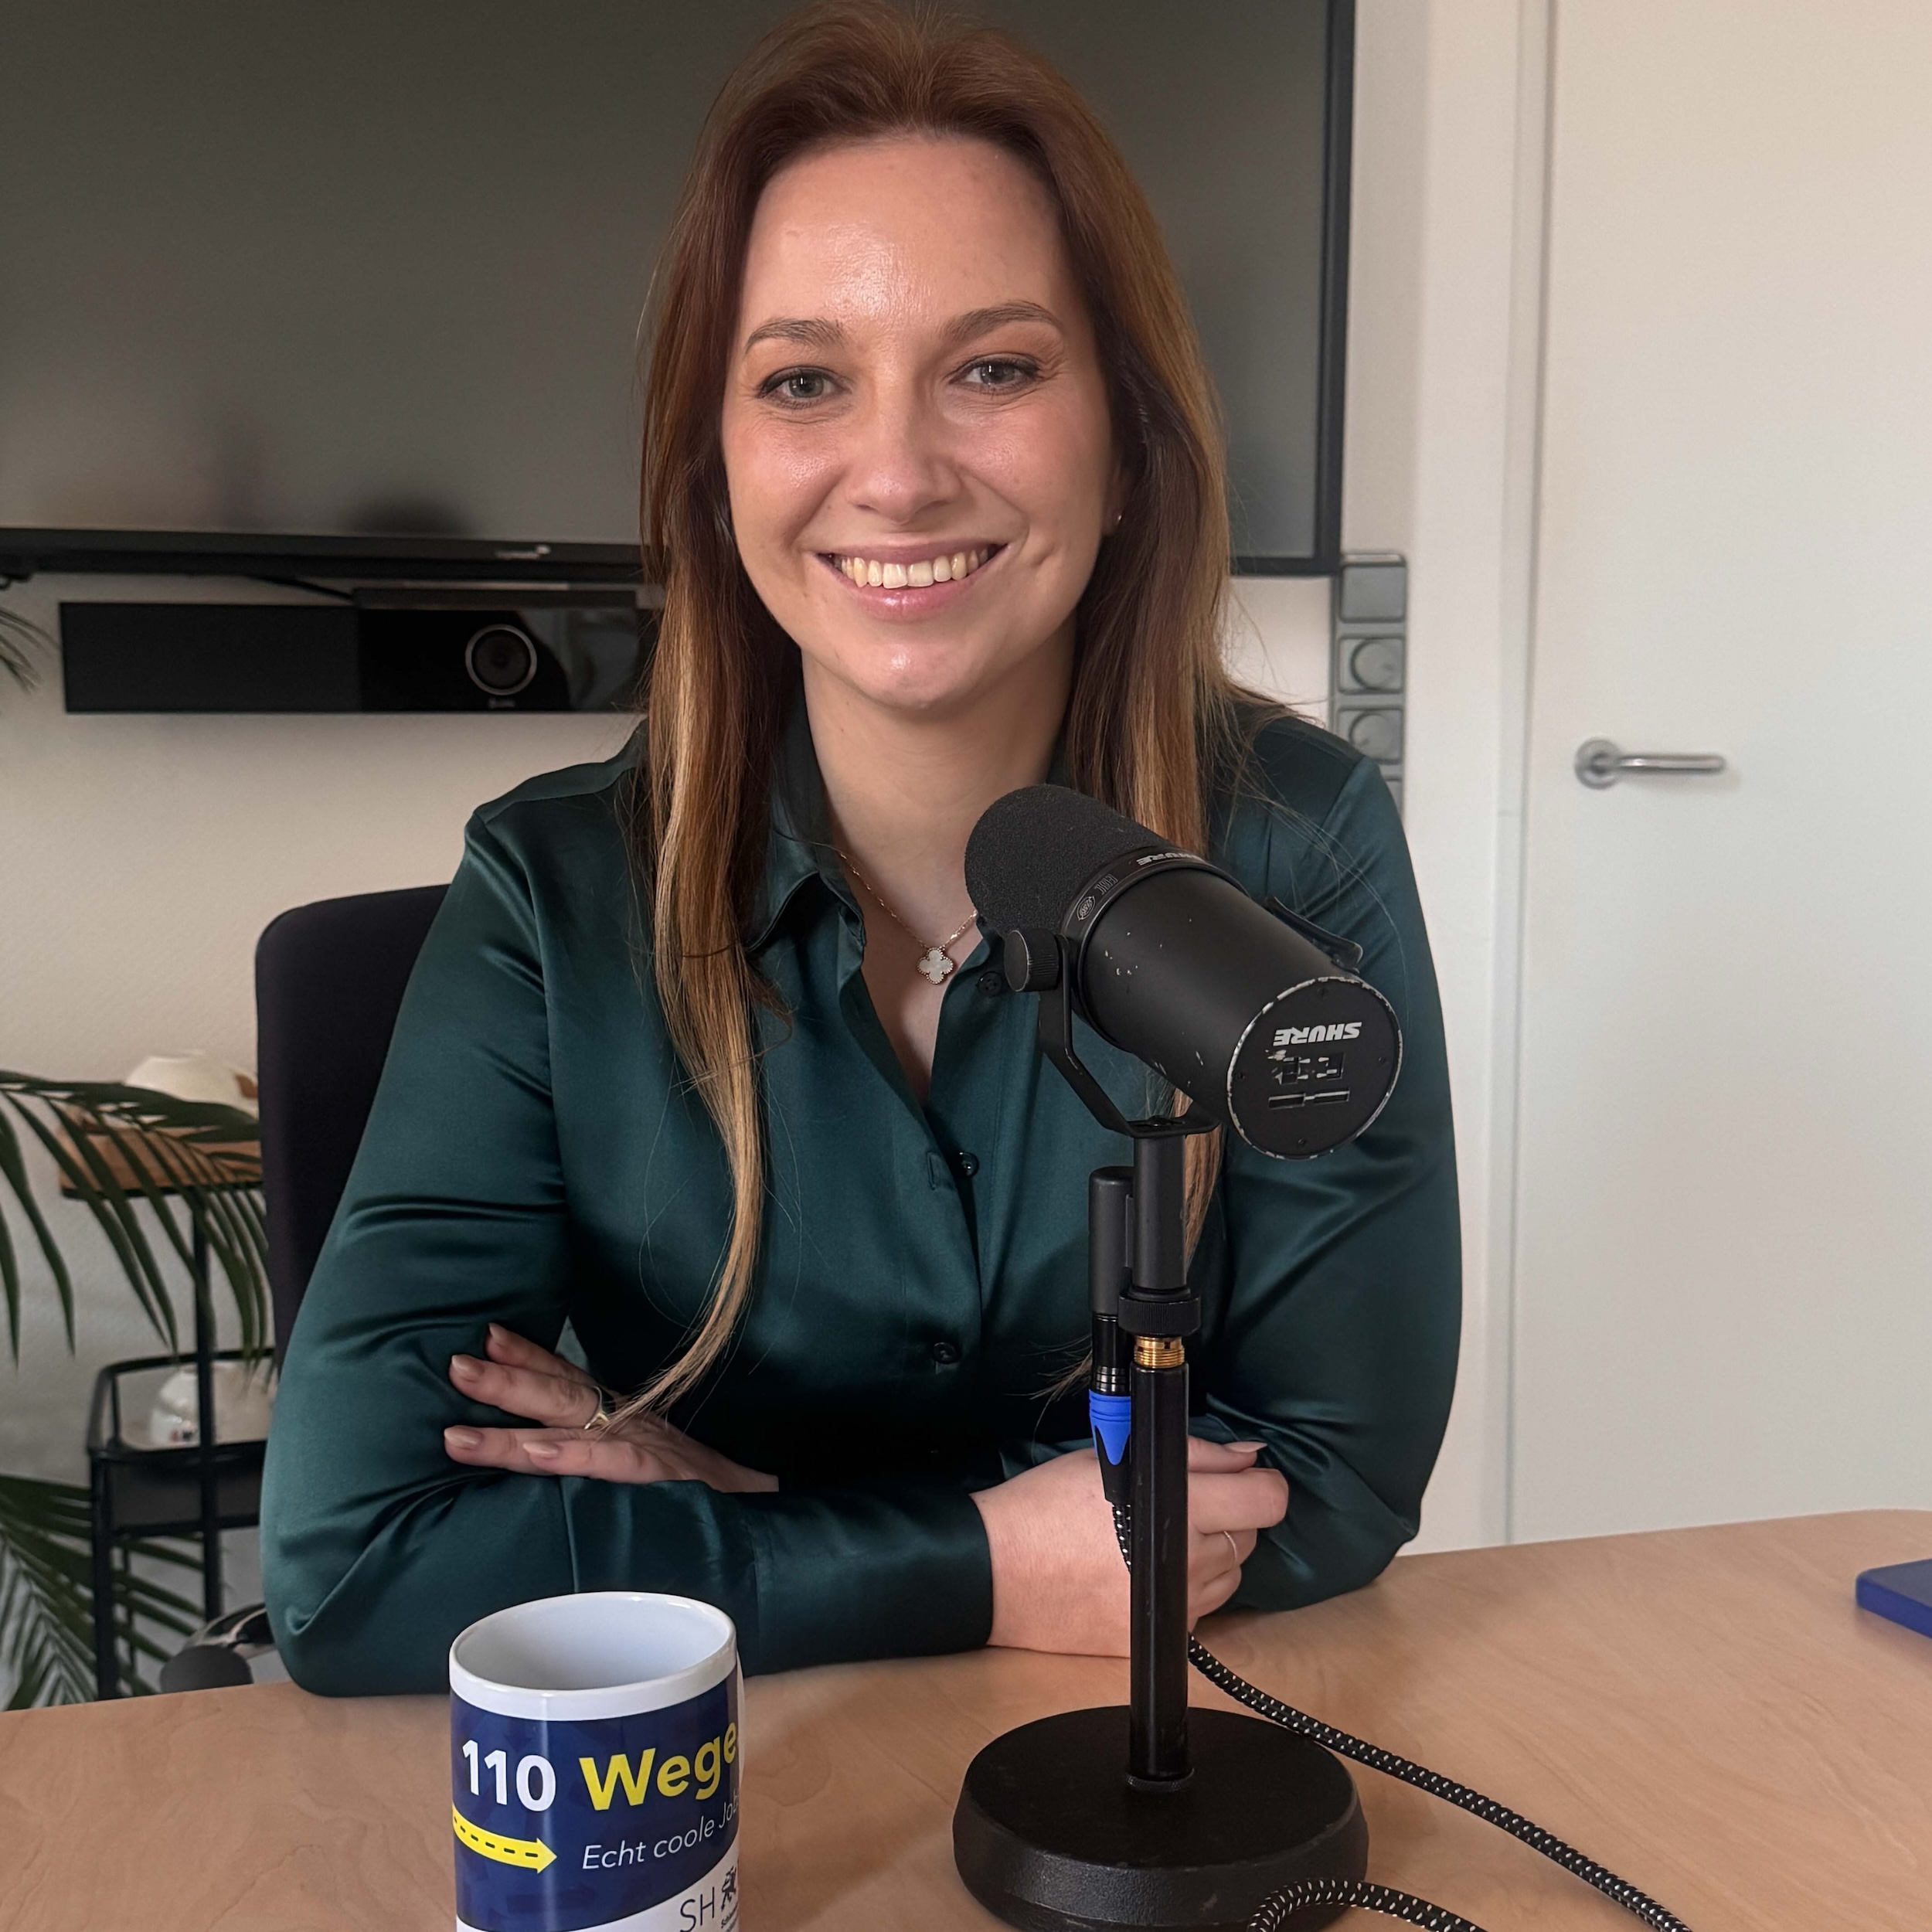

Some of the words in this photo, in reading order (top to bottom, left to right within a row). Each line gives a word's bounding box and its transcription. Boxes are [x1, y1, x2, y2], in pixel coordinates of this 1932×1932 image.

[1136, 852, 1202, 866] HURE
[1273, 1022, 1362, 1046] SHURE
[462, 1739, 556, 1811] 110
[578, 1722, 736, 1811] Wege
[581, 1841, 648, 1870] Echt
[653, 1816, 715, 1858] coole
[679, 1886, 715, 1932] SH
